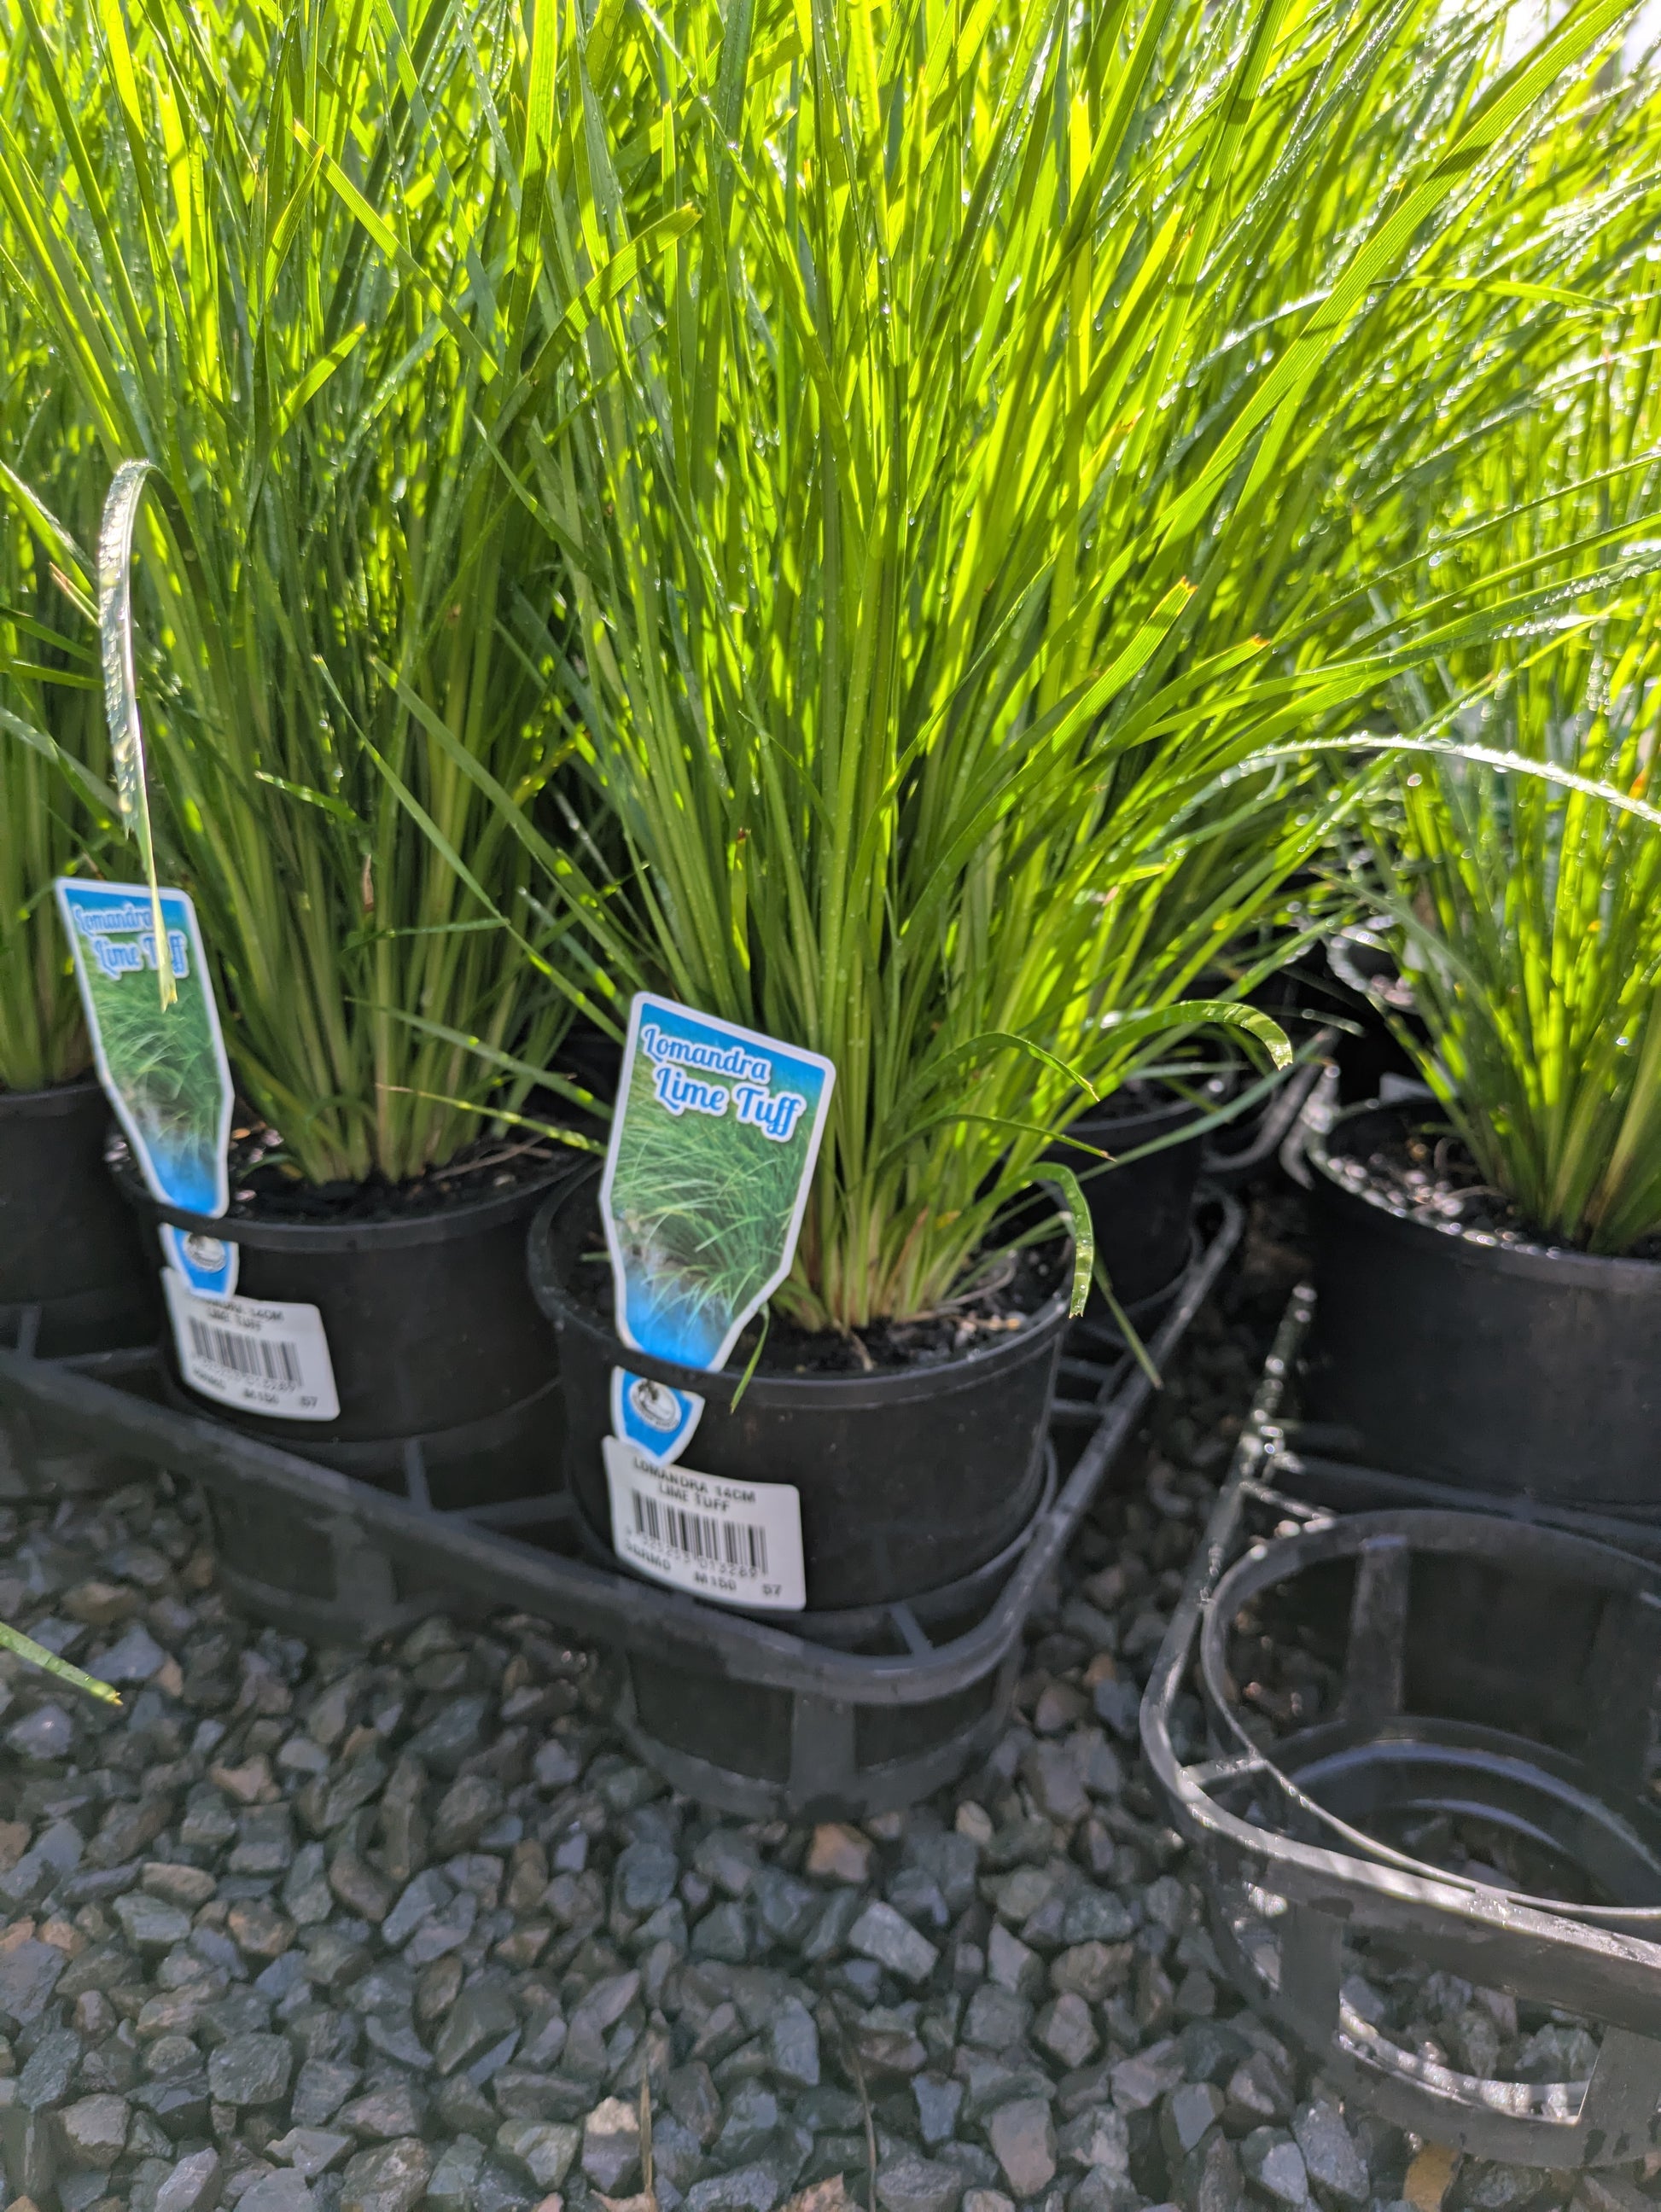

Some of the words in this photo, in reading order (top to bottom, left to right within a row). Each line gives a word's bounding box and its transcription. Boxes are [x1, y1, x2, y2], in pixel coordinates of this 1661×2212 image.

[143, 935, 186, 975] Tff
[643, 1027, 768, 1081] Lomandra
[656, 1067, 726, 1110] Lime
[736, 1086, 802, 1137] Tuff
[633, 1458, 708, 1493] LOMANDRA
[660, 1481, 689, 1502] LIME
[696, 1492, 730, 1511] TUFF
